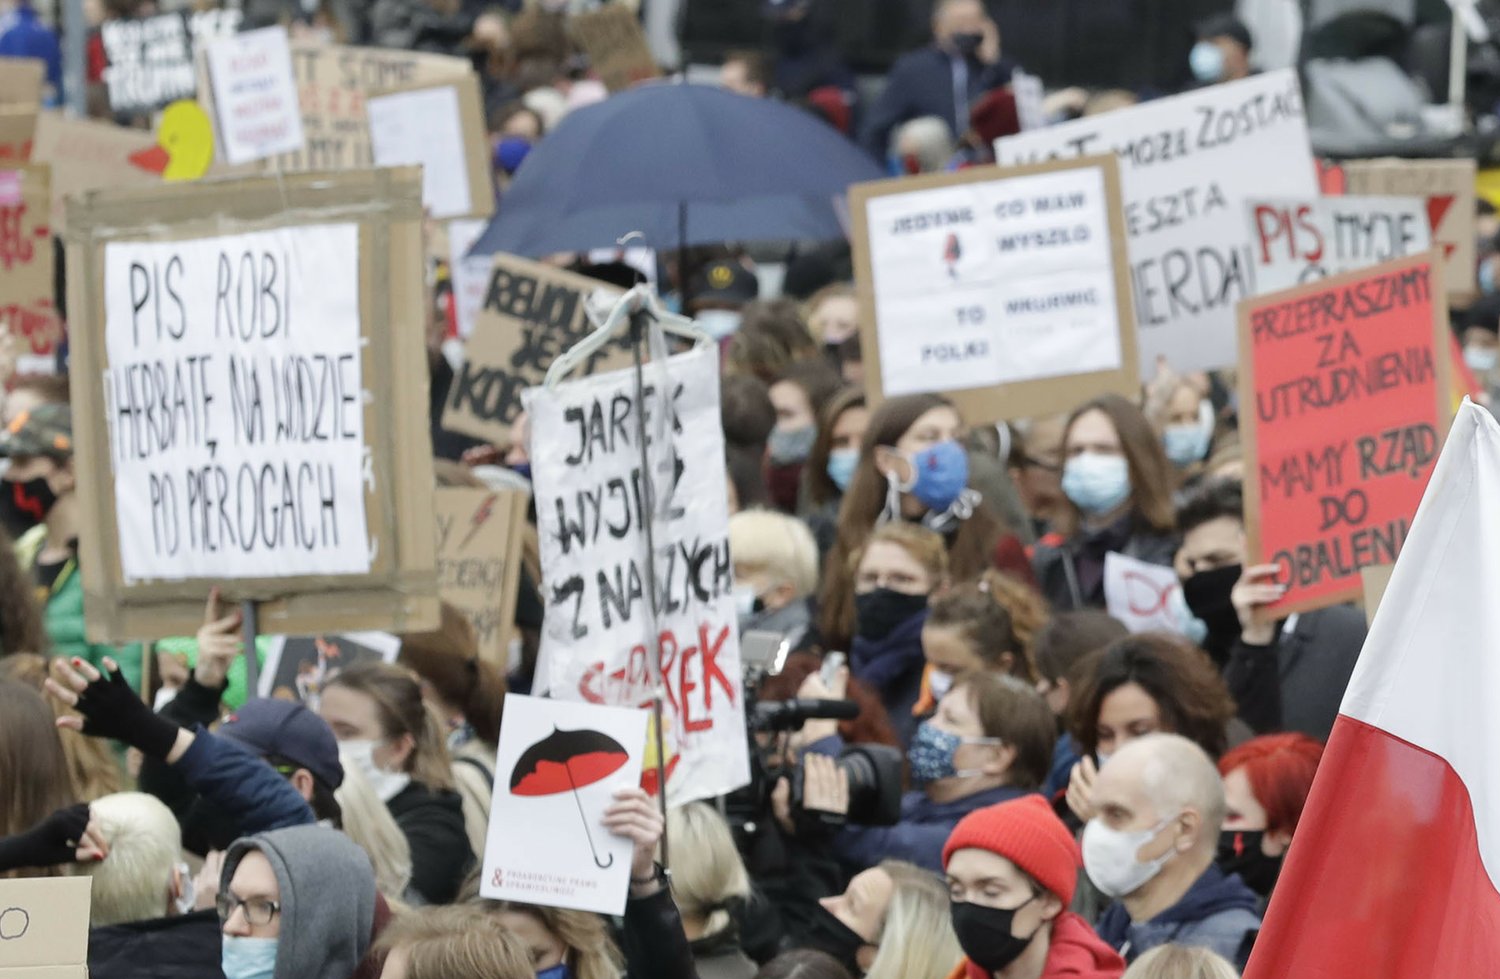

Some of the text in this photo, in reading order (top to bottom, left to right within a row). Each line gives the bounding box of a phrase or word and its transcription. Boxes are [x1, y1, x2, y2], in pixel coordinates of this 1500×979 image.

[994, 200, 1024, 218] CO
[1126, 183, 1227, 238] ESZTA
[1253, 203, 1325, 265] PIS
[130, 254, 187, 346] PIS
[216, 250, 292, 343] ROBI
[956, 305, 986, 325] TO
[1252, 269, 1431, 344] PRZEPRASZAMY
[1256, 346, 1437, 422] UTRUDNIENIA
[1315, 330, 1362, 368] ZA
[114, 354, 356, 462] HERBATĘ NA WODZIE
[1259, 422, 1440, 500] MAMY RZĄD
[149, 471, 180, 557] PO
[1320, 488, 1368, 532] DO
[597, 536, 731, 630] NAZYCH
